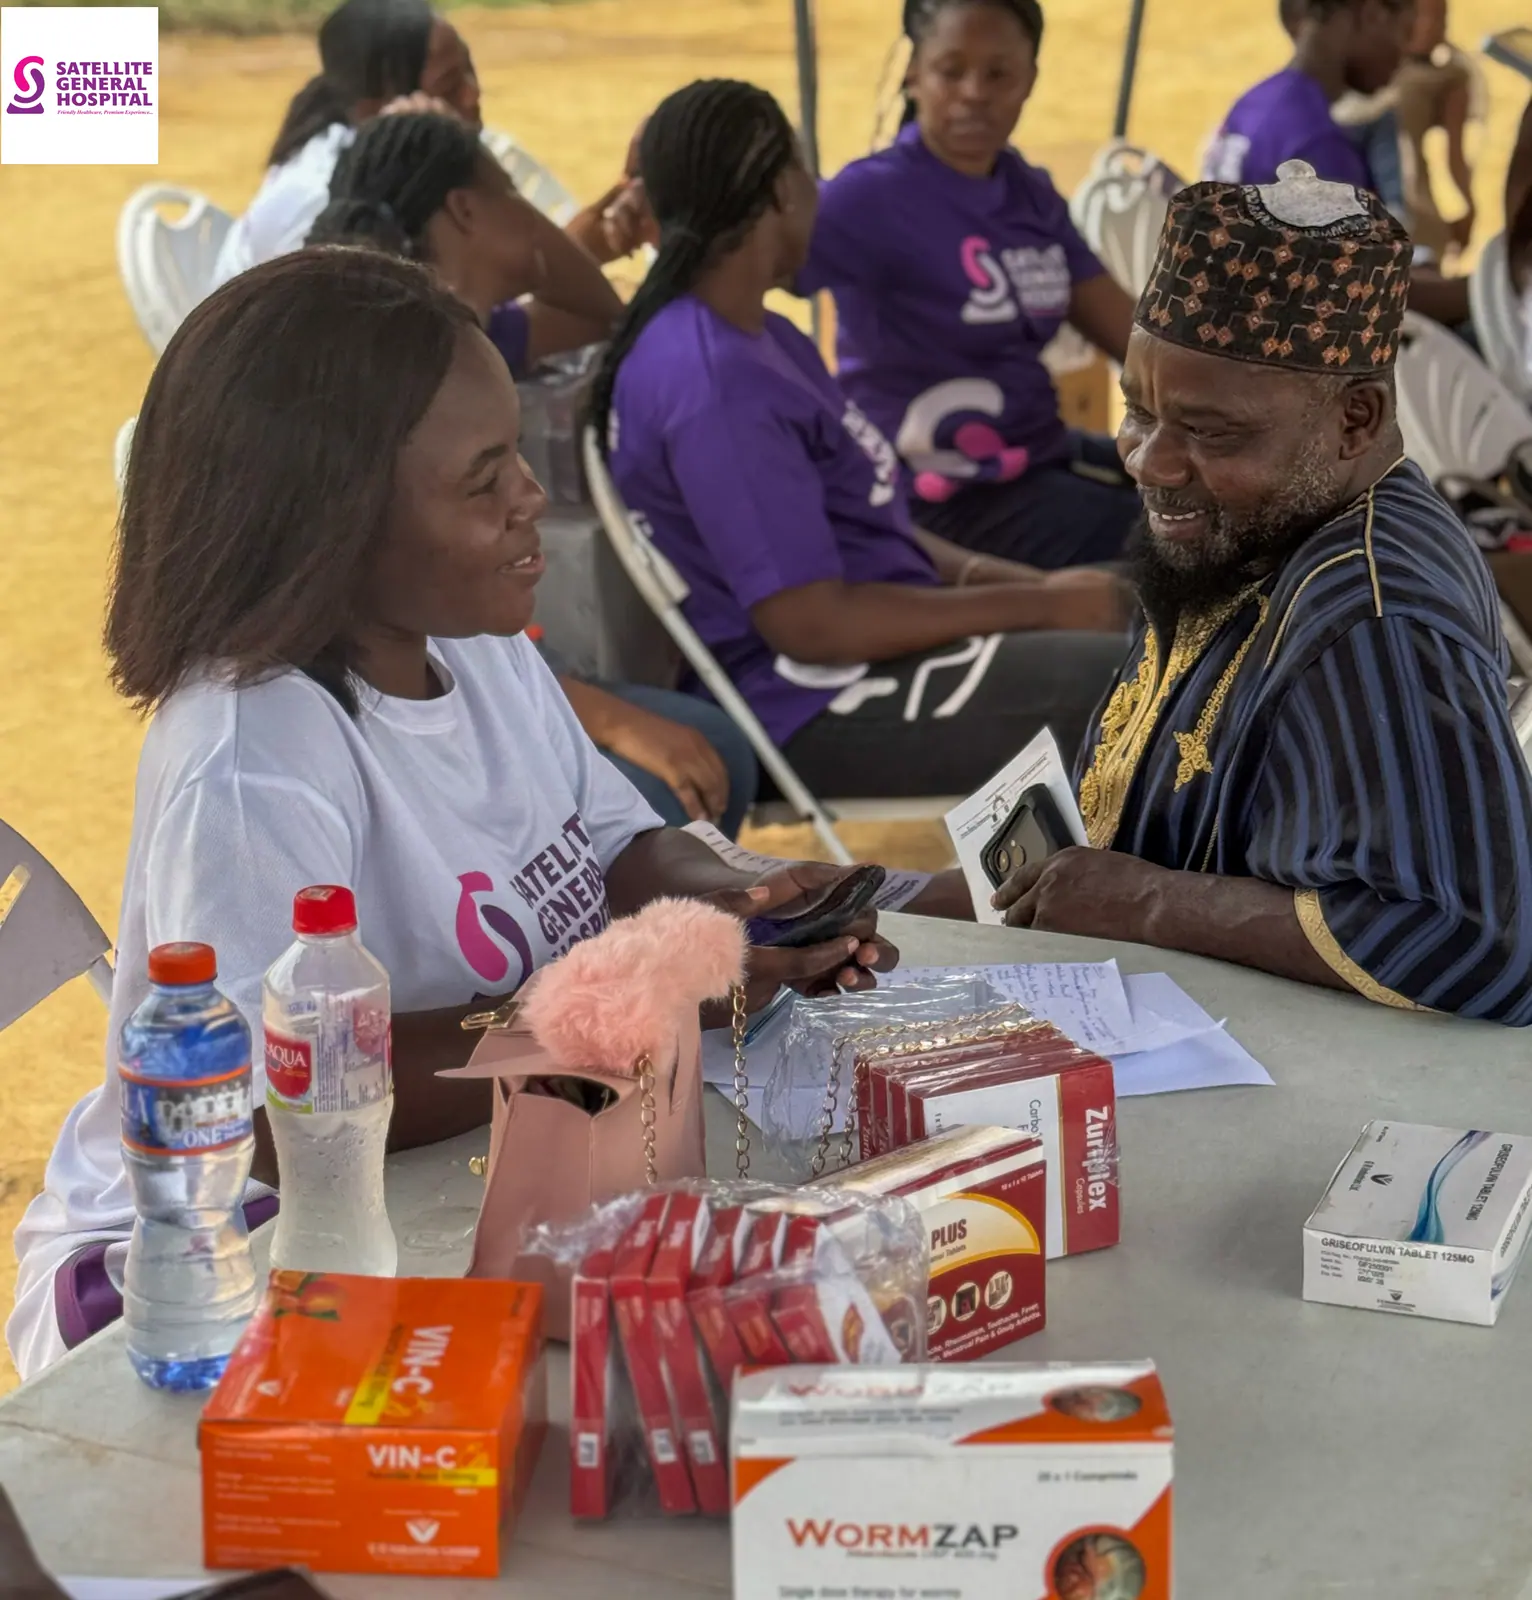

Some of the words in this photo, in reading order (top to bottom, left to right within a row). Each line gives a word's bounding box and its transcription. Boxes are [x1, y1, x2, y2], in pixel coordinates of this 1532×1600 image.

[537, 857, 604, 945] GENERA
[931, 1218, 967, 1250] PLUS
[1321, 1237, 1396, 1256] GRISEOFULVIN
[1399, 1247, 1438, 1260] TABLET
[1441, 1252, 1475, 1264] 125MG
[391, 1325, 454, 1395] VIN-C
[366, 1444, 457, 1470] VIN-C
[786, 1518, 1019, 1549] WORMZAP
